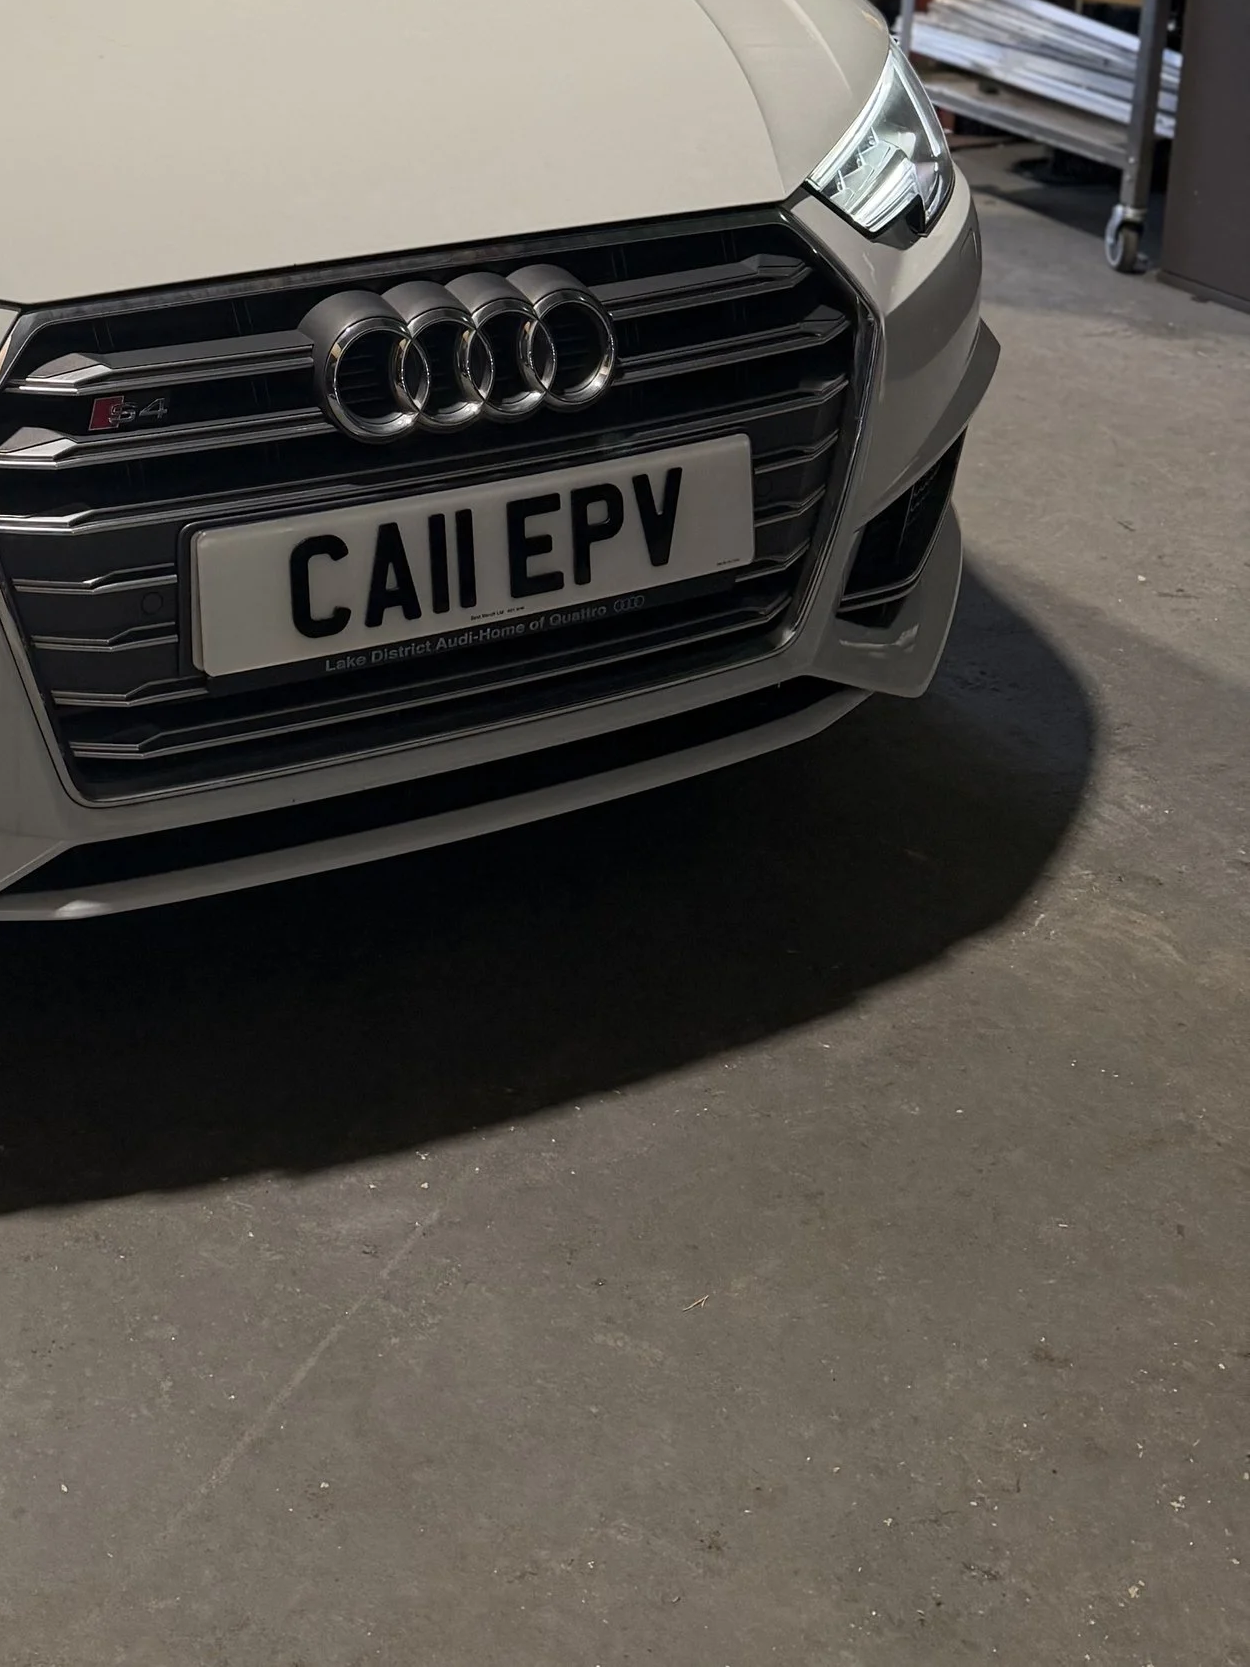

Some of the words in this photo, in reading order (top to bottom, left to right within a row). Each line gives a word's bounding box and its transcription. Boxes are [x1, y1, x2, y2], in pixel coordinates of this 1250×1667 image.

[108, 397, 167, 424] S4
[290, 508, 477, 638] CA11
[506, 467, 682, 598] EPV
[325, 655, 366, 672] Lake
[371, 640, 431, 664] District
[436, 622, 525, 651] Audi-Home
[529, 616, 546, 631] of
[549, 605, 608, 626] Quattro
